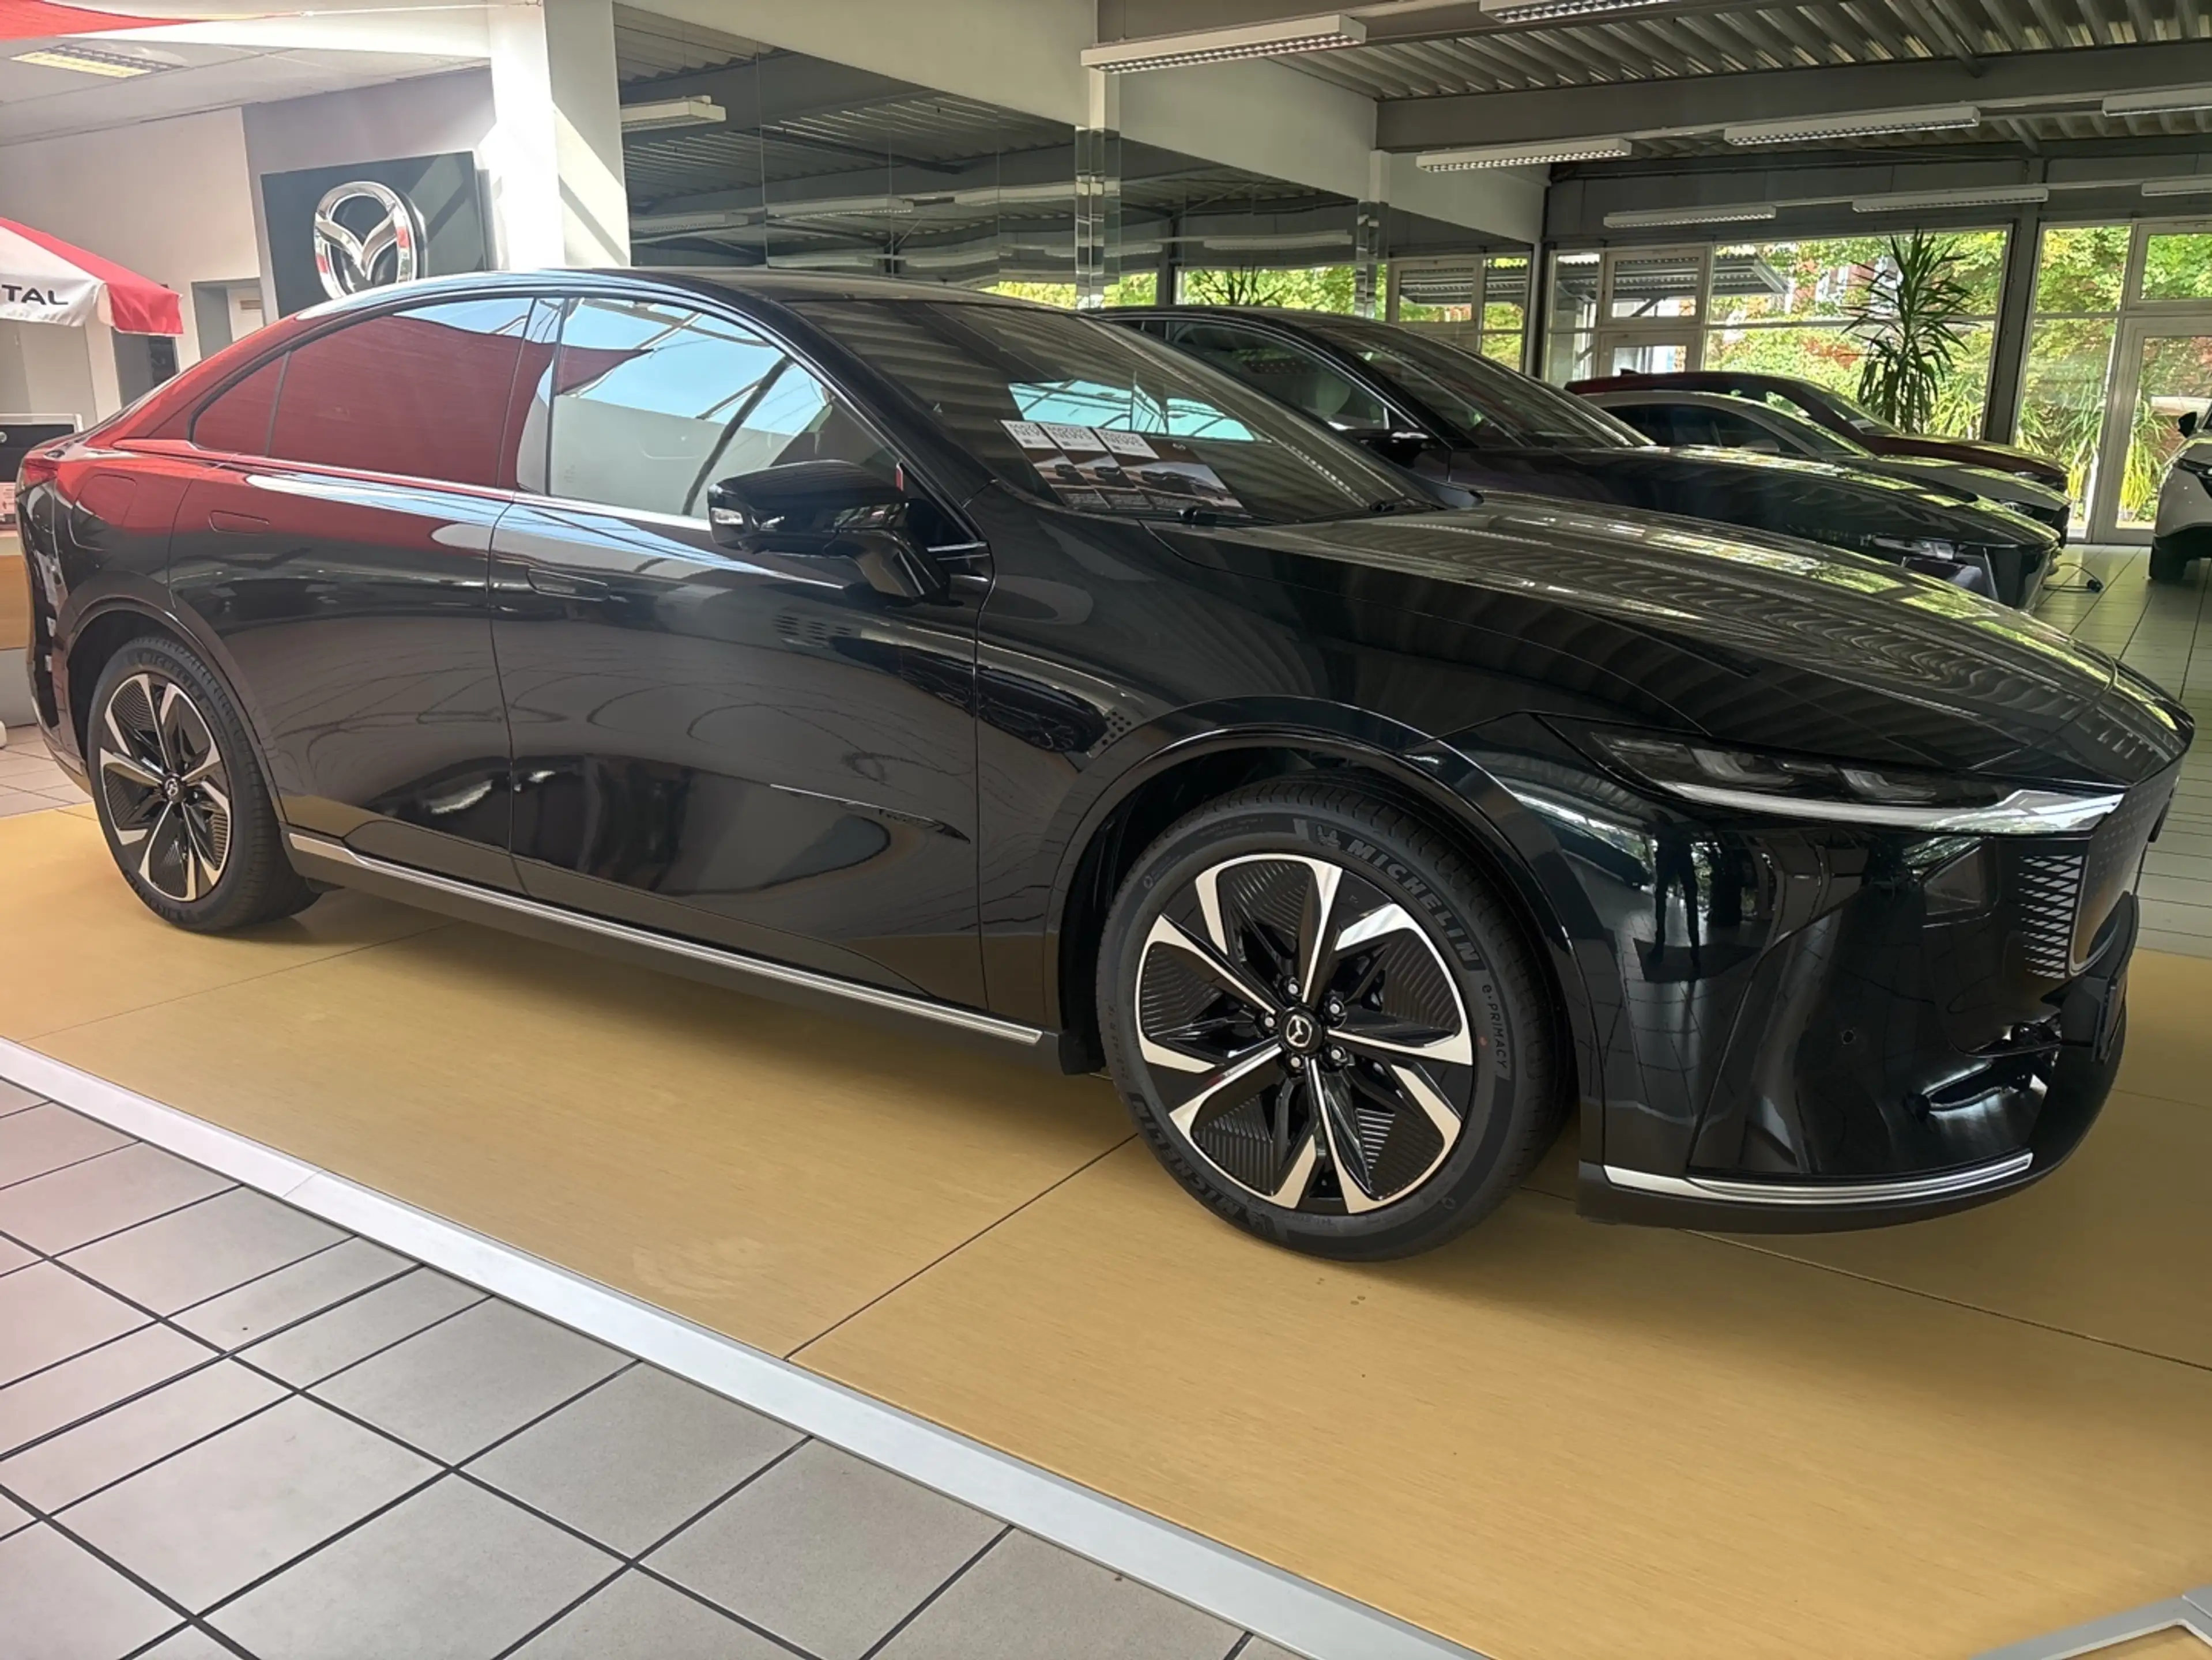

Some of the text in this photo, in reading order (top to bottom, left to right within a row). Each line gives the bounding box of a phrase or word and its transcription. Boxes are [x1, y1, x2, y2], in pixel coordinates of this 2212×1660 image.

[2, 284, 69, 305] TAL
[1347, 839, 1480, 961] MICHELIN
[1131, 1099, 1241, 1217] MICHELIN
